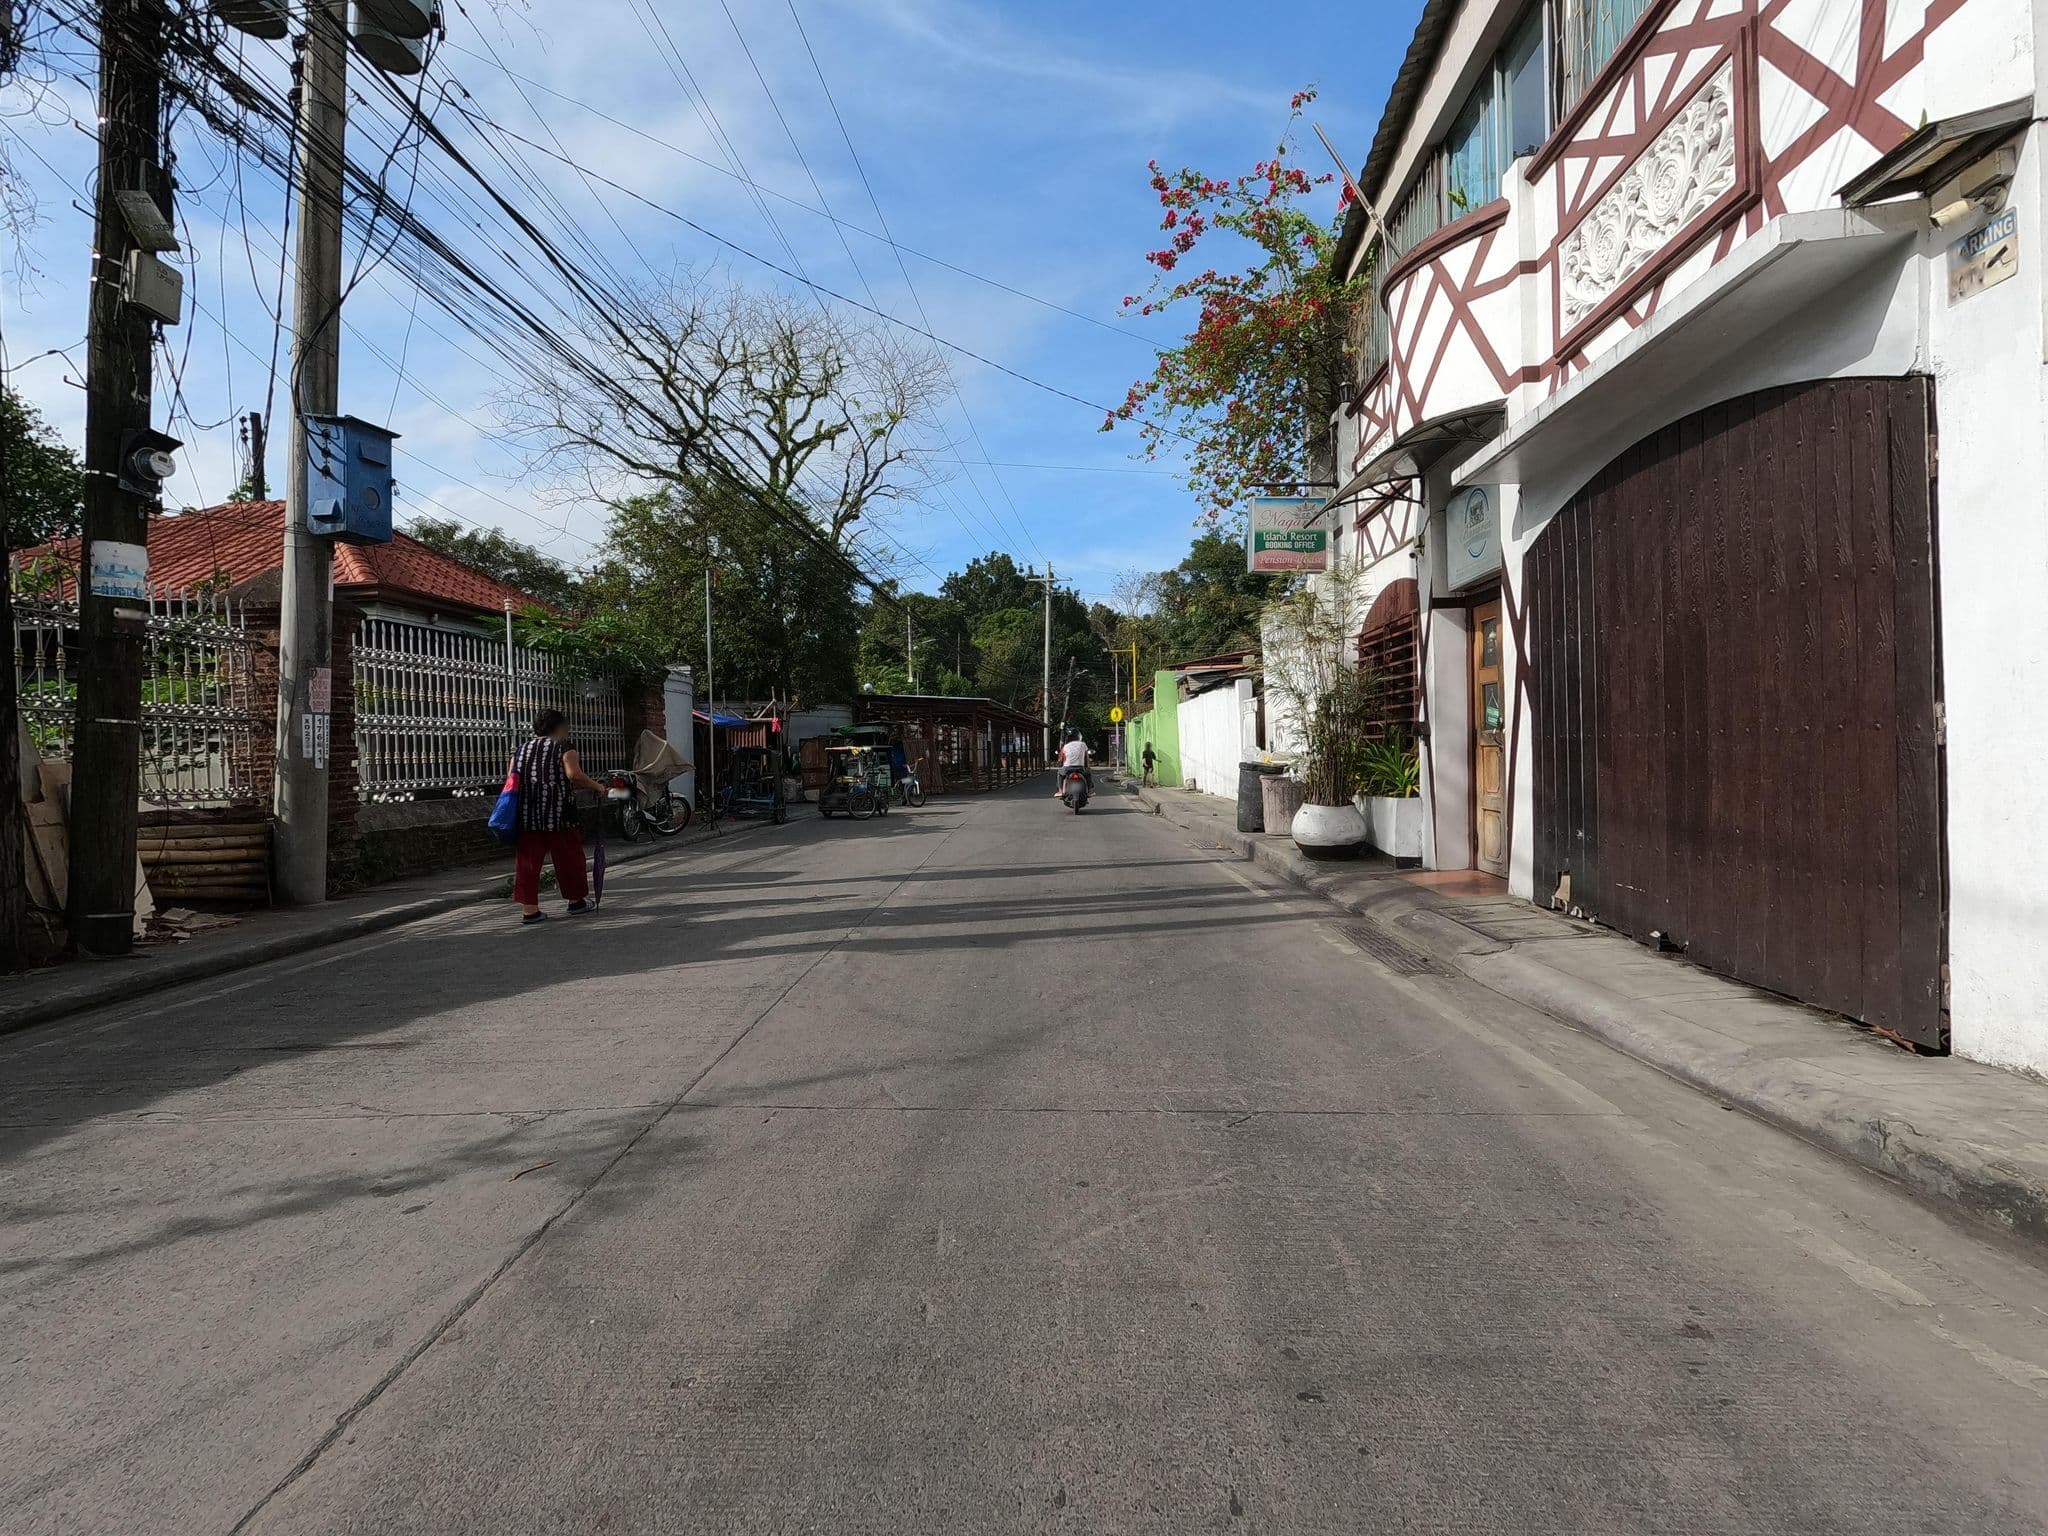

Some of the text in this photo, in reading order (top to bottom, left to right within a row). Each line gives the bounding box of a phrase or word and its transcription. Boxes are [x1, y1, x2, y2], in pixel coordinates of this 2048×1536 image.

[1263, 531, 1317, 541] Island Resort
[1265, 541, 1316, 549] BOOKING OFFICE
